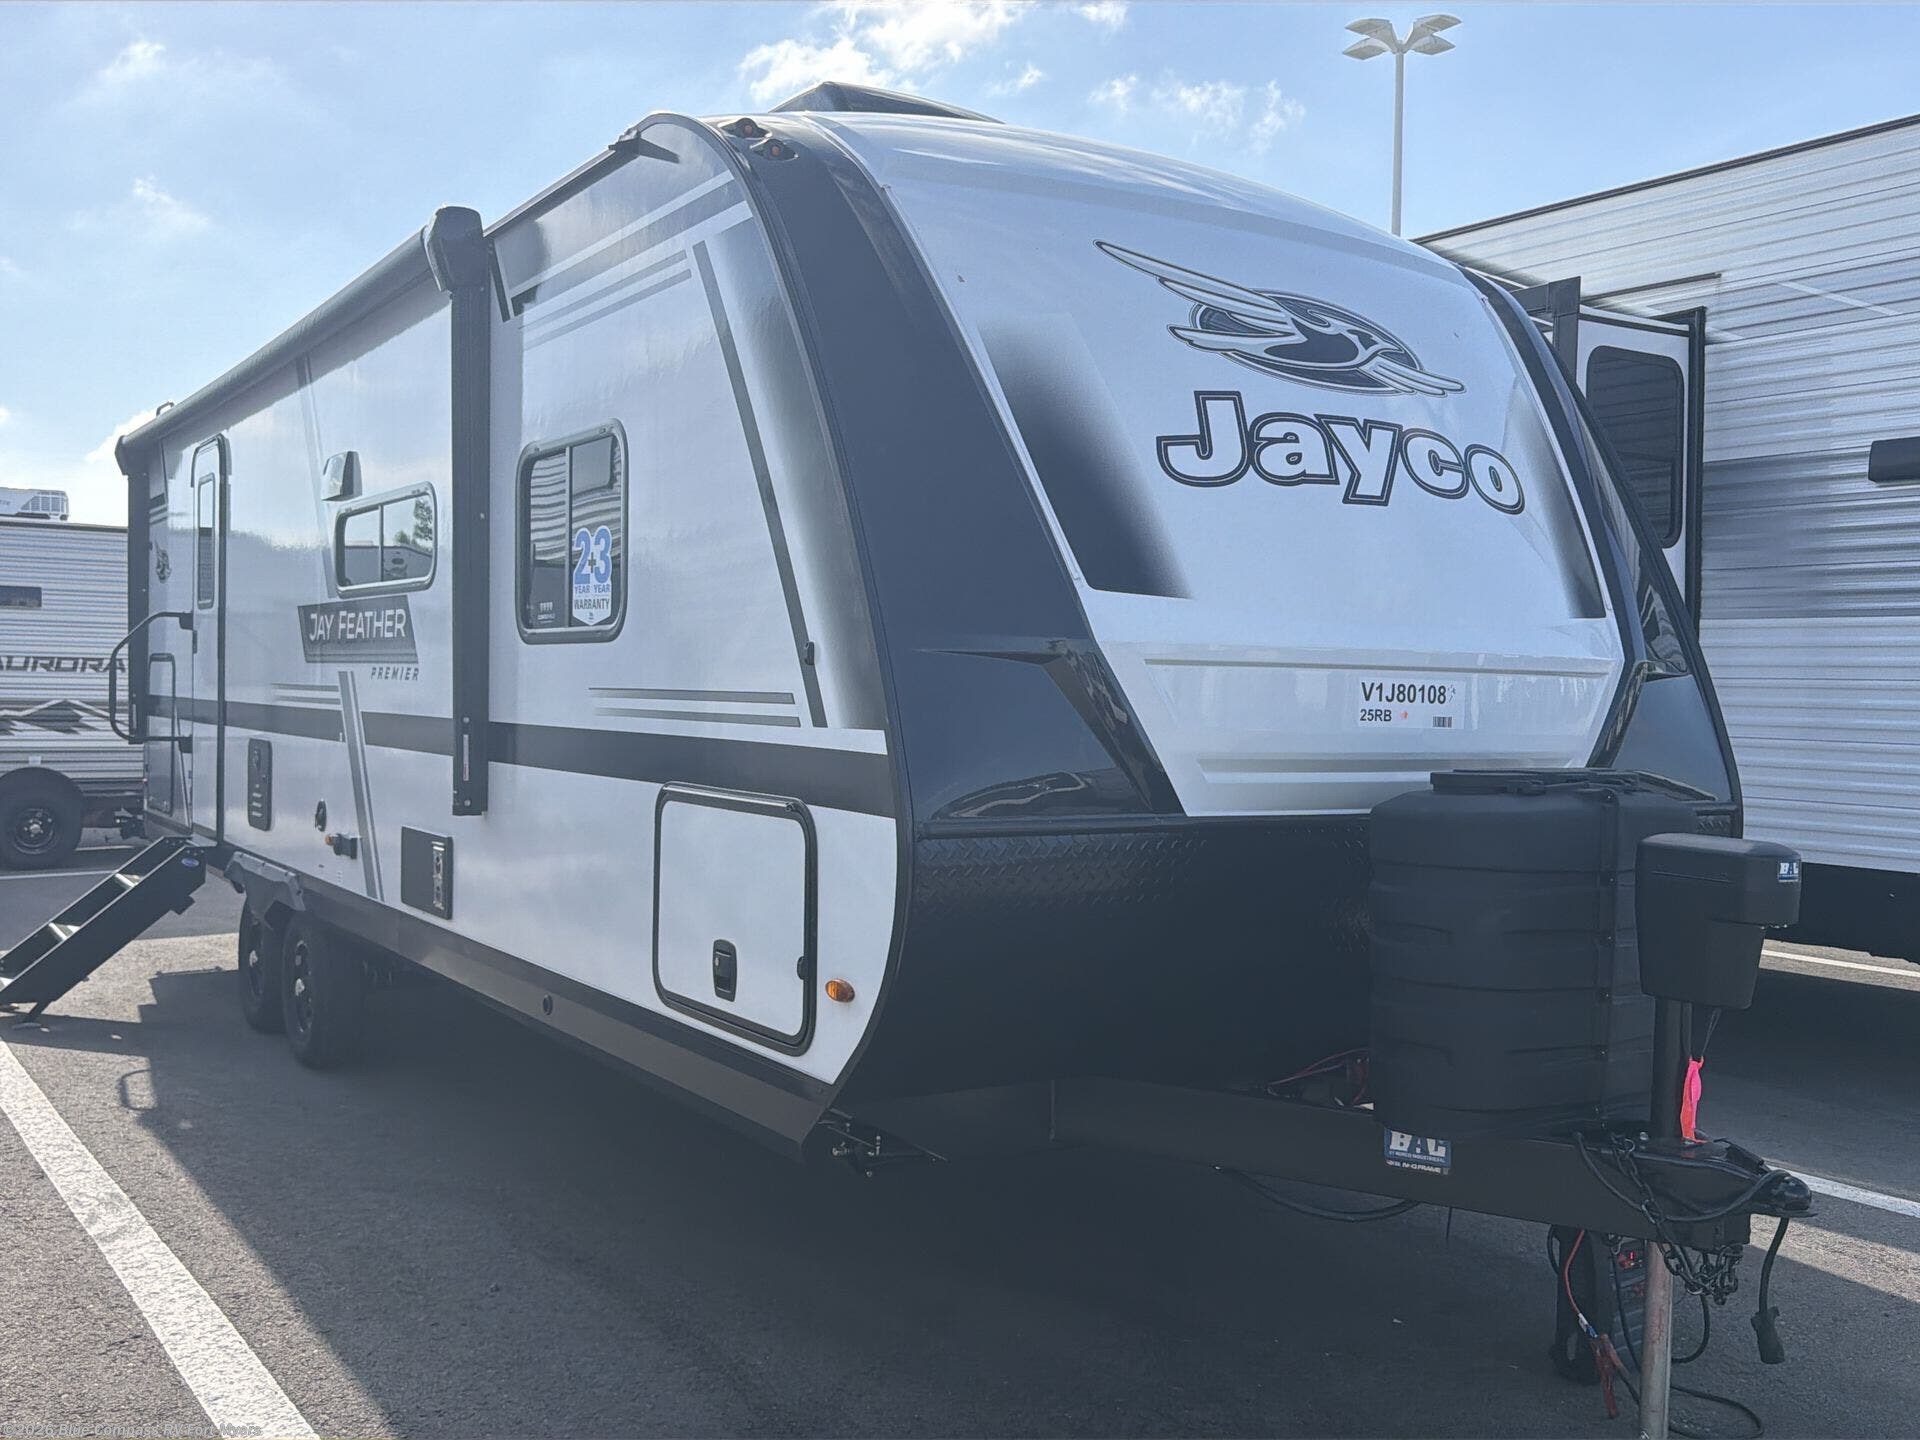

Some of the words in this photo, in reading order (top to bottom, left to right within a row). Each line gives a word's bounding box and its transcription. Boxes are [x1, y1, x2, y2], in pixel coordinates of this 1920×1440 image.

[1156, 390, 1524, 515] Jayco
[574, 585, 590, 594] YEAR
[594, 584, 611, 593] YEAR
[574, 598, 611, 610] WARRANTY
[309, 613, 335, 641] JAY
[338, 608, 406, 640] FEATHER
[0, 655, 126, 673] URORA
[371, 666, 419, 681] PREMIER
[1361, 682, 1447, 704] V1J80108
[1360, 709, 1392, 722] 25RB
